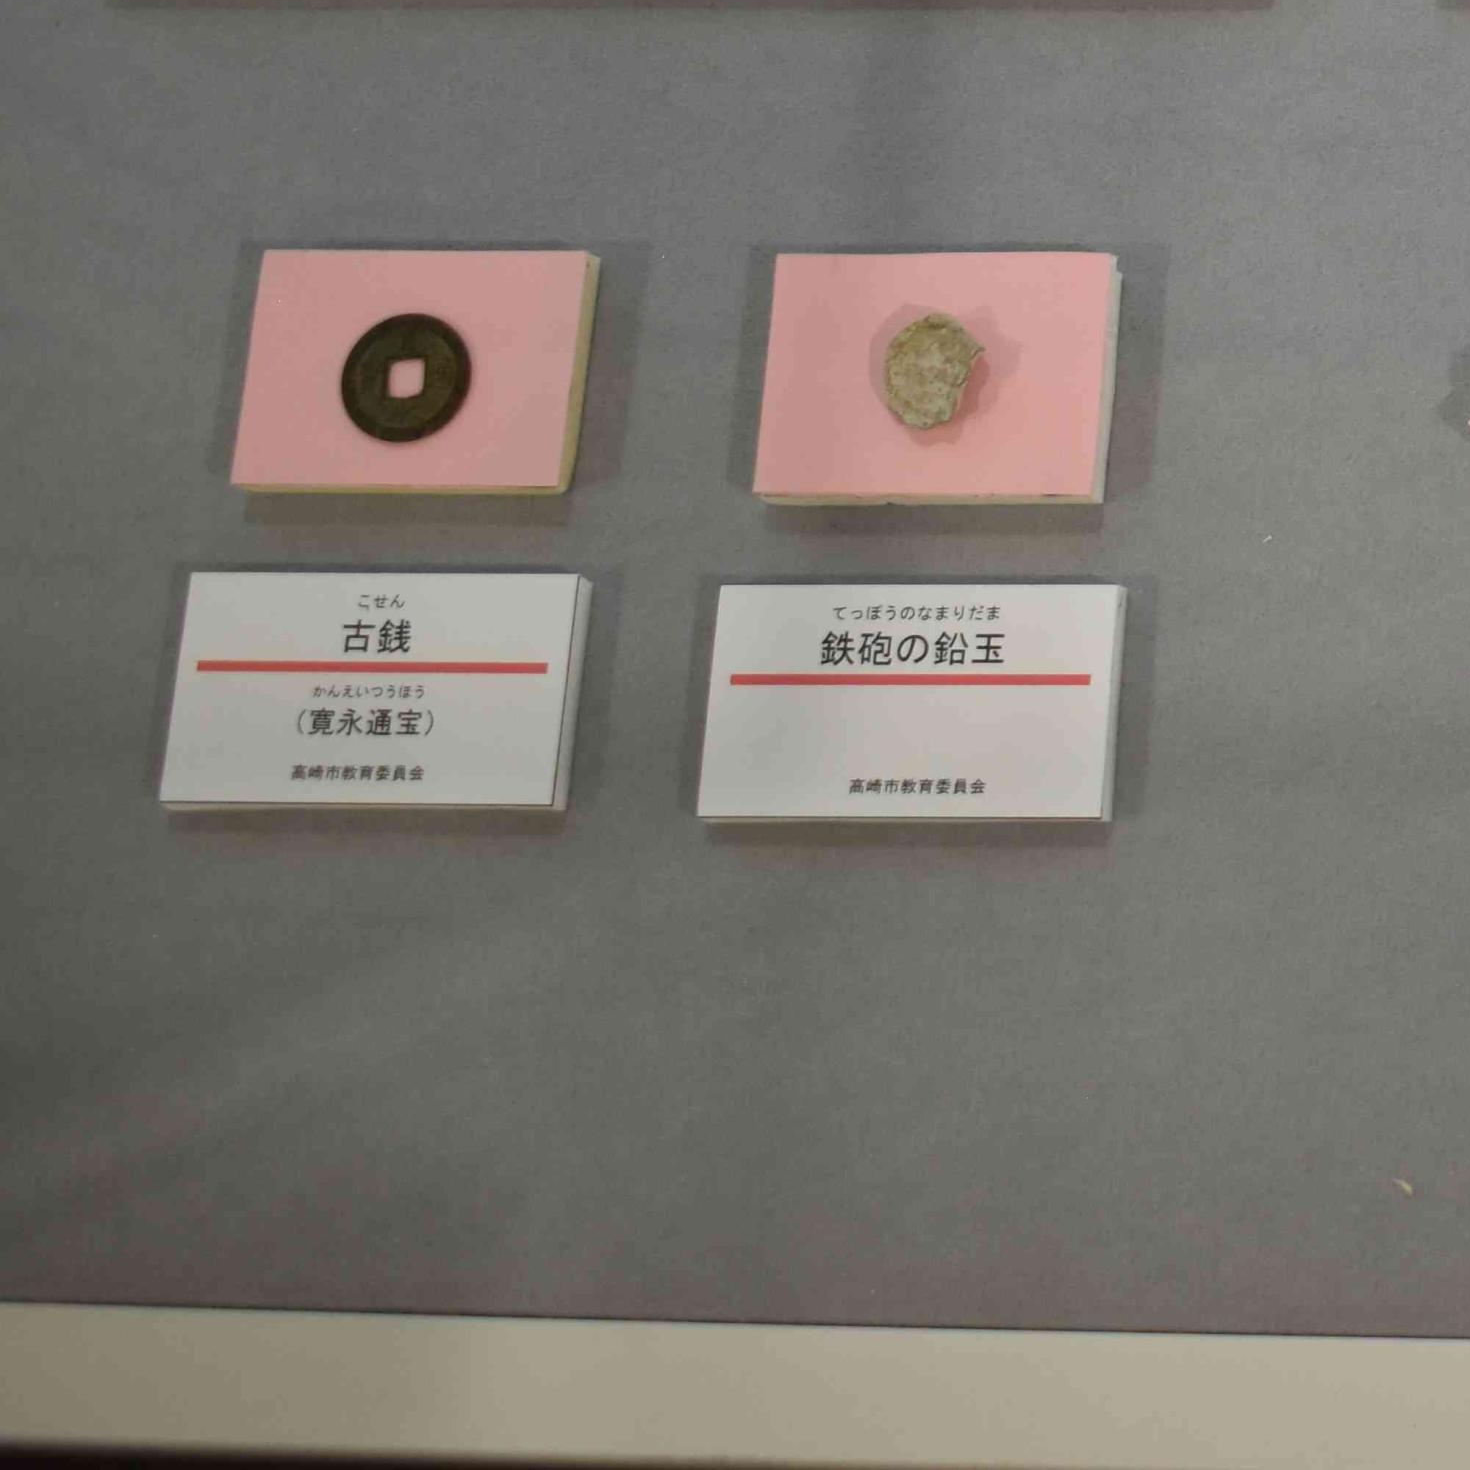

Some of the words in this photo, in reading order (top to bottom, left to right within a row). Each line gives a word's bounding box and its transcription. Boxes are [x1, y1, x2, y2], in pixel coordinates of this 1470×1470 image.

[357, 594, 405, 611] こせん
[832, 605, 1001, 621] てっぽうのなまりだま
[343, 619, 411, 654] 古銭
[820, 631, 1005, 666] 鉄砲の鉛玉
[312, 684, 425, 699] かんえいつうほう
[297, 707, 434, 736] （寛永通宝）
[291, 764, 423, 781] 高崎市教育委員会
[849, 778, 985, 795] 高崎市教育委員会
